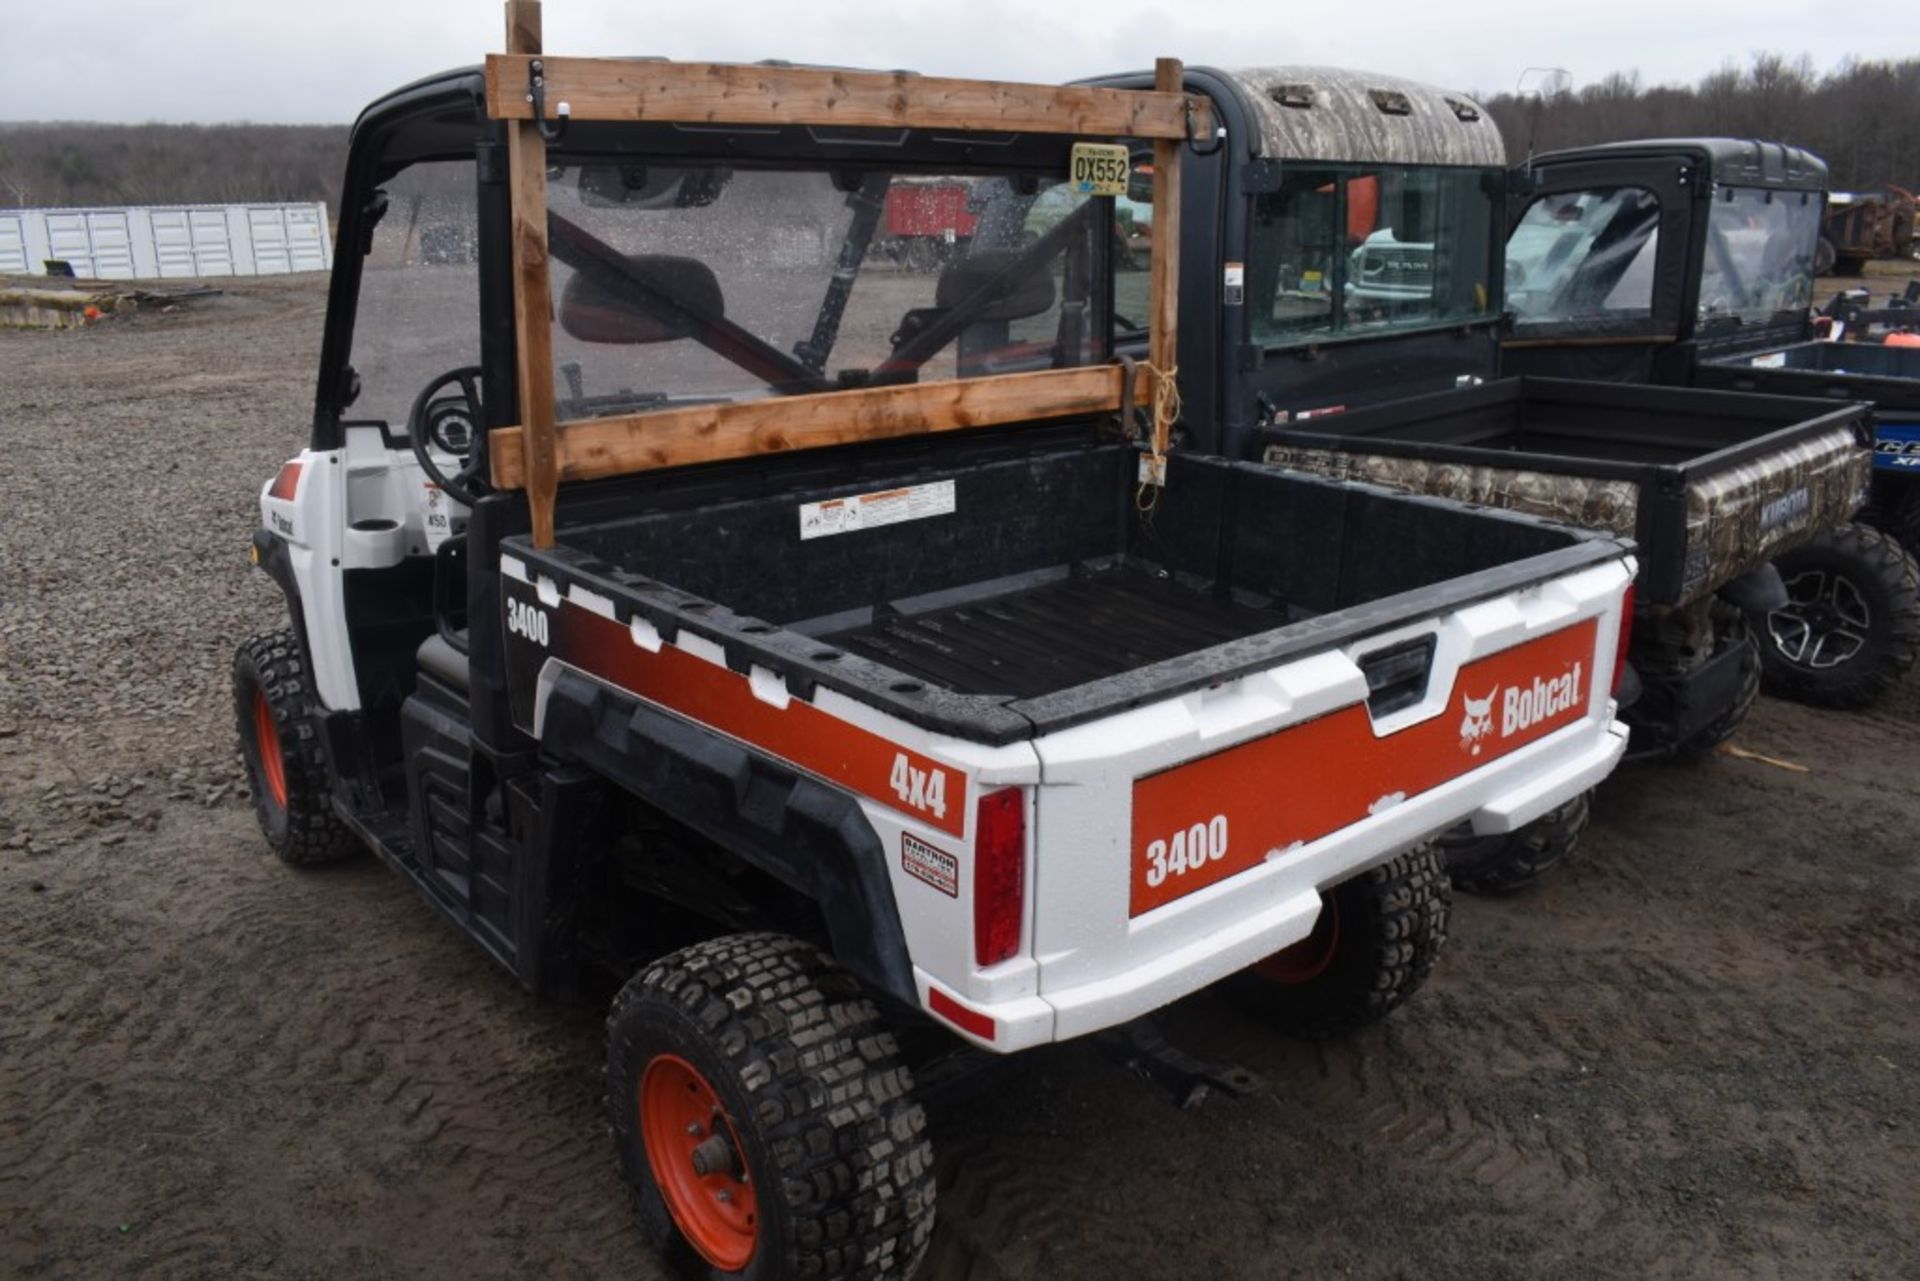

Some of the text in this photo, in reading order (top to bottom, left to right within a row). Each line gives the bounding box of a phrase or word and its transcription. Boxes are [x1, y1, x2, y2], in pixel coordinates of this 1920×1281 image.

[507, 596, 549, 647] 3400
[1501, 661, 1582, 738] Bobcat
[889, 752, 946, 819] 4x4
[1146, 814, 1228, 888] 3400
